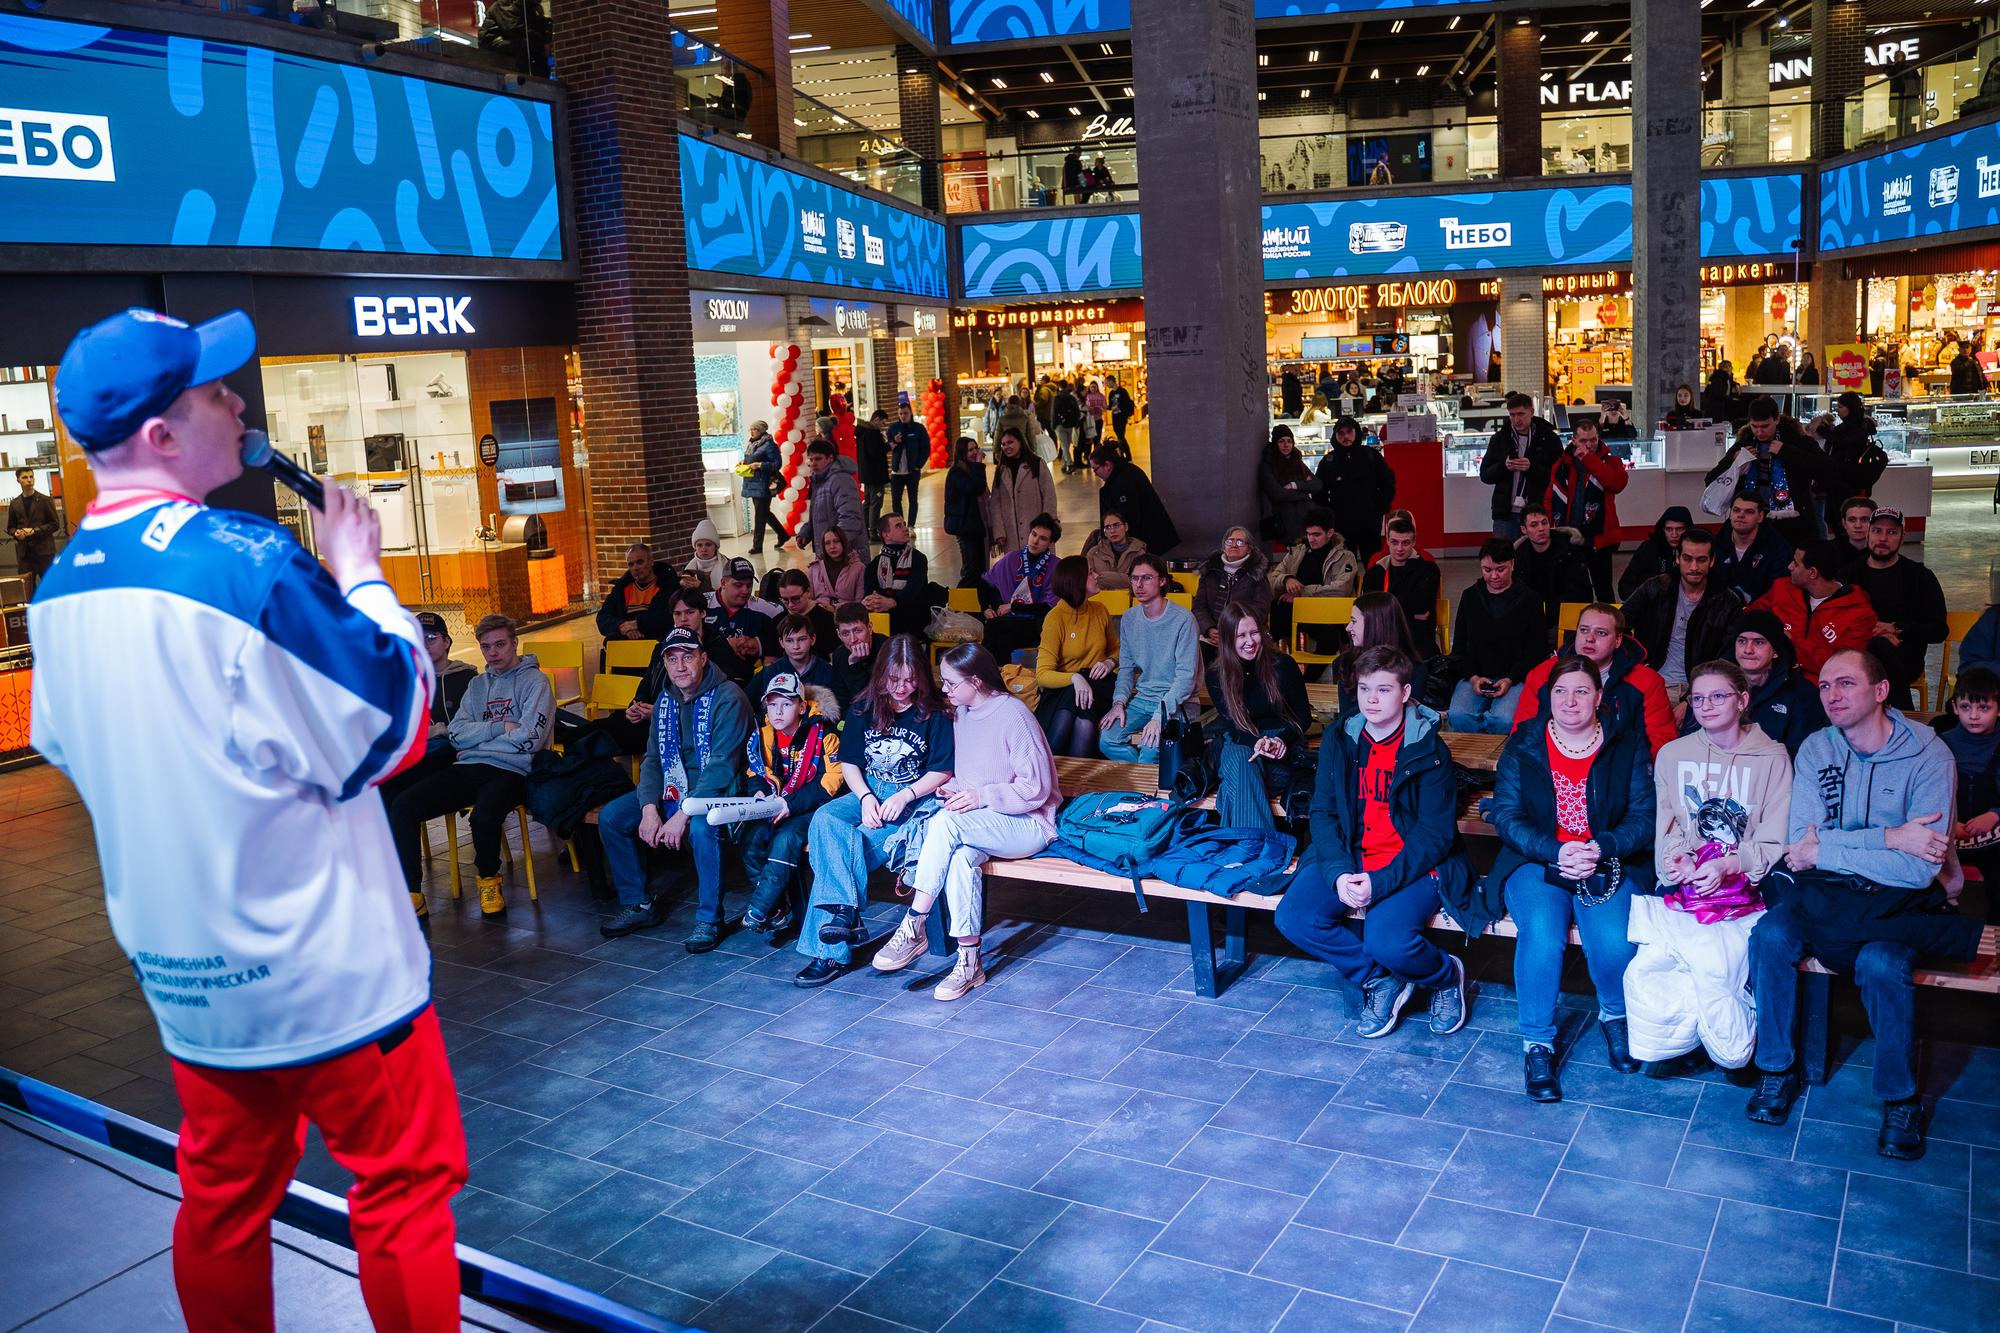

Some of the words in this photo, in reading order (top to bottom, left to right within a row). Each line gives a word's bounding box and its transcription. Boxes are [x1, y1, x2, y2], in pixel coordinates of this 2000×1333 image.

[1082, 115, 1137, 141] Bella
[1981, 168, 2000, 193] НЕ
[1450, 227, 1507, 245] НЕБО
[1291, 285, 1370, 314] ЗОЛОТОЕ
[1378, 278, 1455, 308] ЯБЛОКО
[354, 296, 476, 337] BORK
[709, 299, 749, 320] SOKOLOV
[988, 307, 1106, 328] супермаркет
[908, 731, 928, 753] TIME
